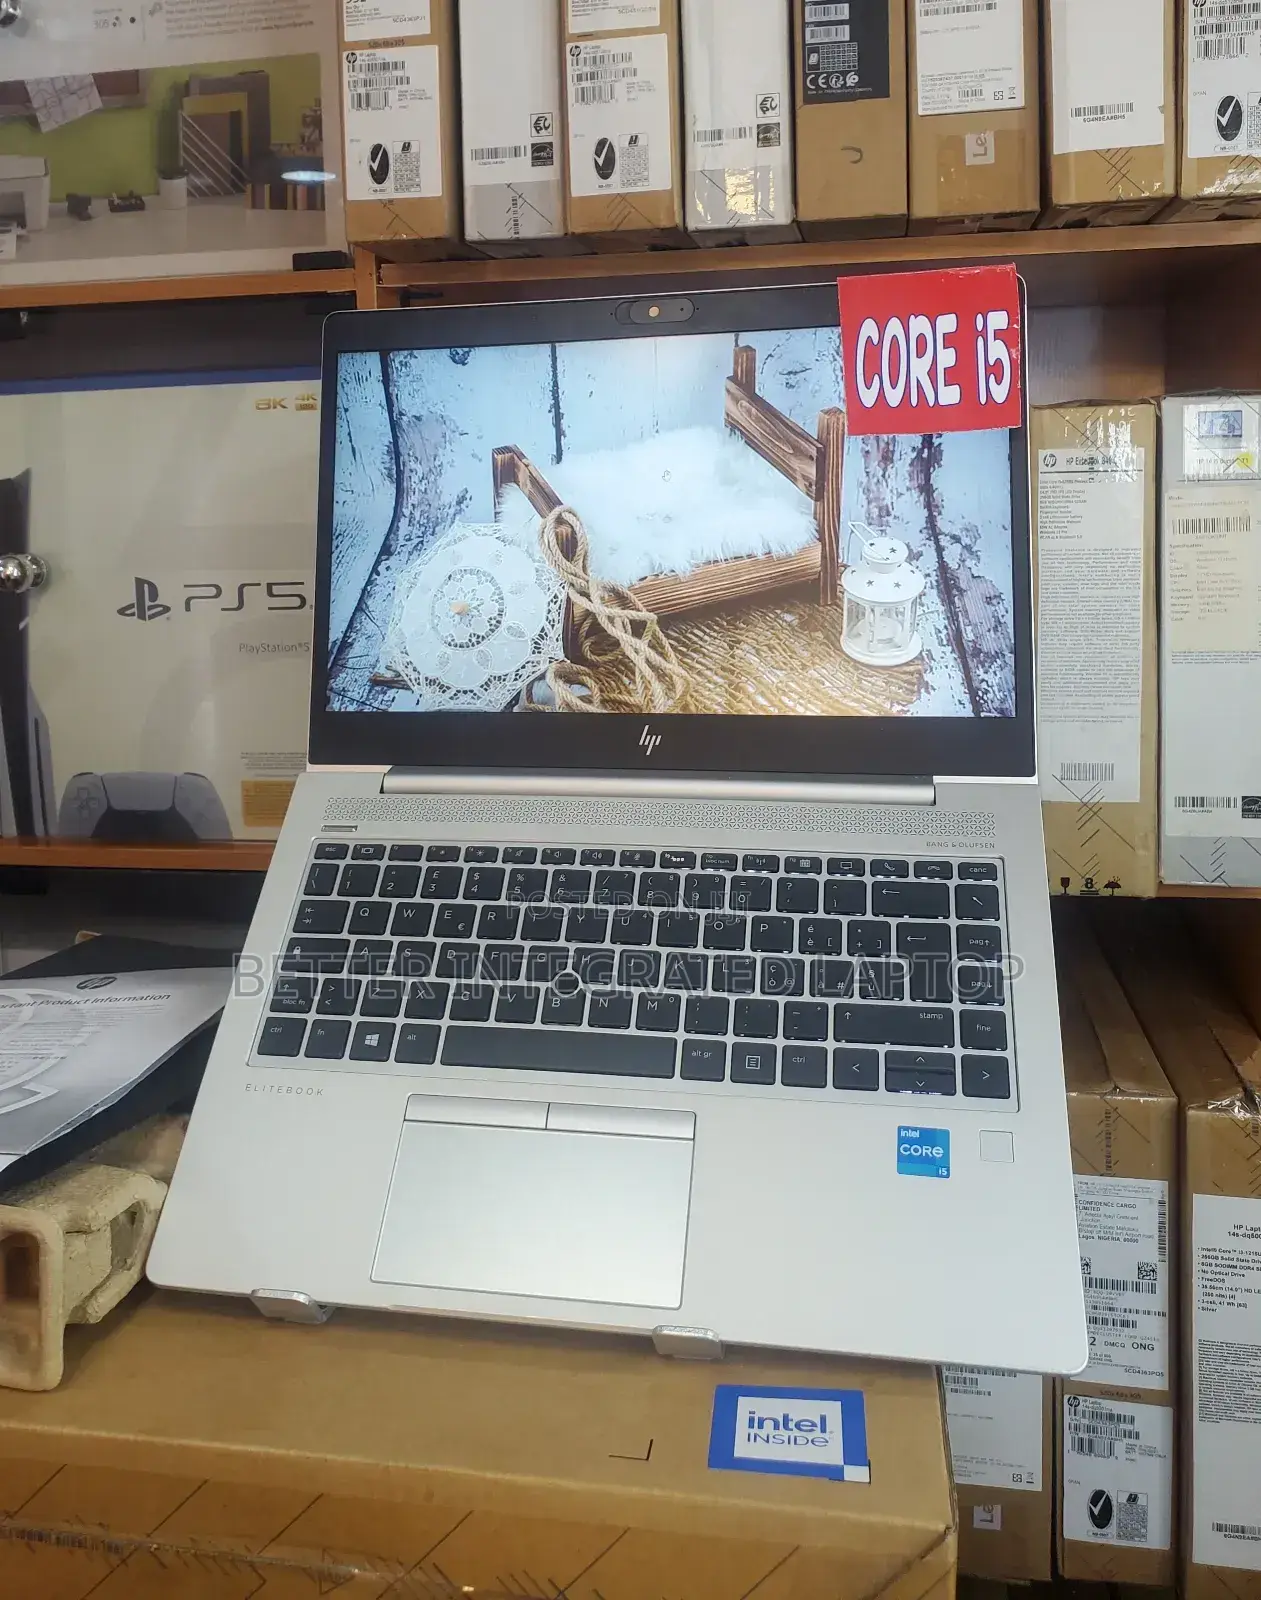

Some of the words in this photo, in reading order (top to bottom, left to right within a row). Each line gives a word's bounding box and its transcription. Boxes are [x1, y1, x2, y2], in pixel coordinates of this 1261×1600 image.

[856, 312, 961, 408] CORE
[975, 310, 1012, 405] i5
[184, 582, 307, 612] PS5
[1084, 878, 1093, 890] 8
[360, 908, 370, 918] Q
[403, 909, 416, 918] W
[444, 910, 452, 919] E
[487, 912, 496, 921] R
[760, 924, 768, 932] P
[536, 953, 546, 962] G
[581, 956, 591, 964] H
[38, 998, 90, 1006] Product
[91, 993, 171, 1004] Information
[552, 998, 560, 1008] B
[600, 998, 608, 1008] N
[648, 1002, 658, 1010] M
[920, 1012, 944, 1020] stamp
[976, 1024, 991, 1032] fine
[792, 1056, 806, 1064] ctrl
[245, 1084, 324, 1096] ELITEBOOK
[900, 1129, 920, 1138] intel
[939, 1168, 948, 1176] i5
[1078, 1200, 1114, 1208] CONFIDENCE
[1090, 1336, 1096, 1346] 2
[1132, 1342, 1154, 1351] ONG
[748, 1410, 828, 1434] intel
